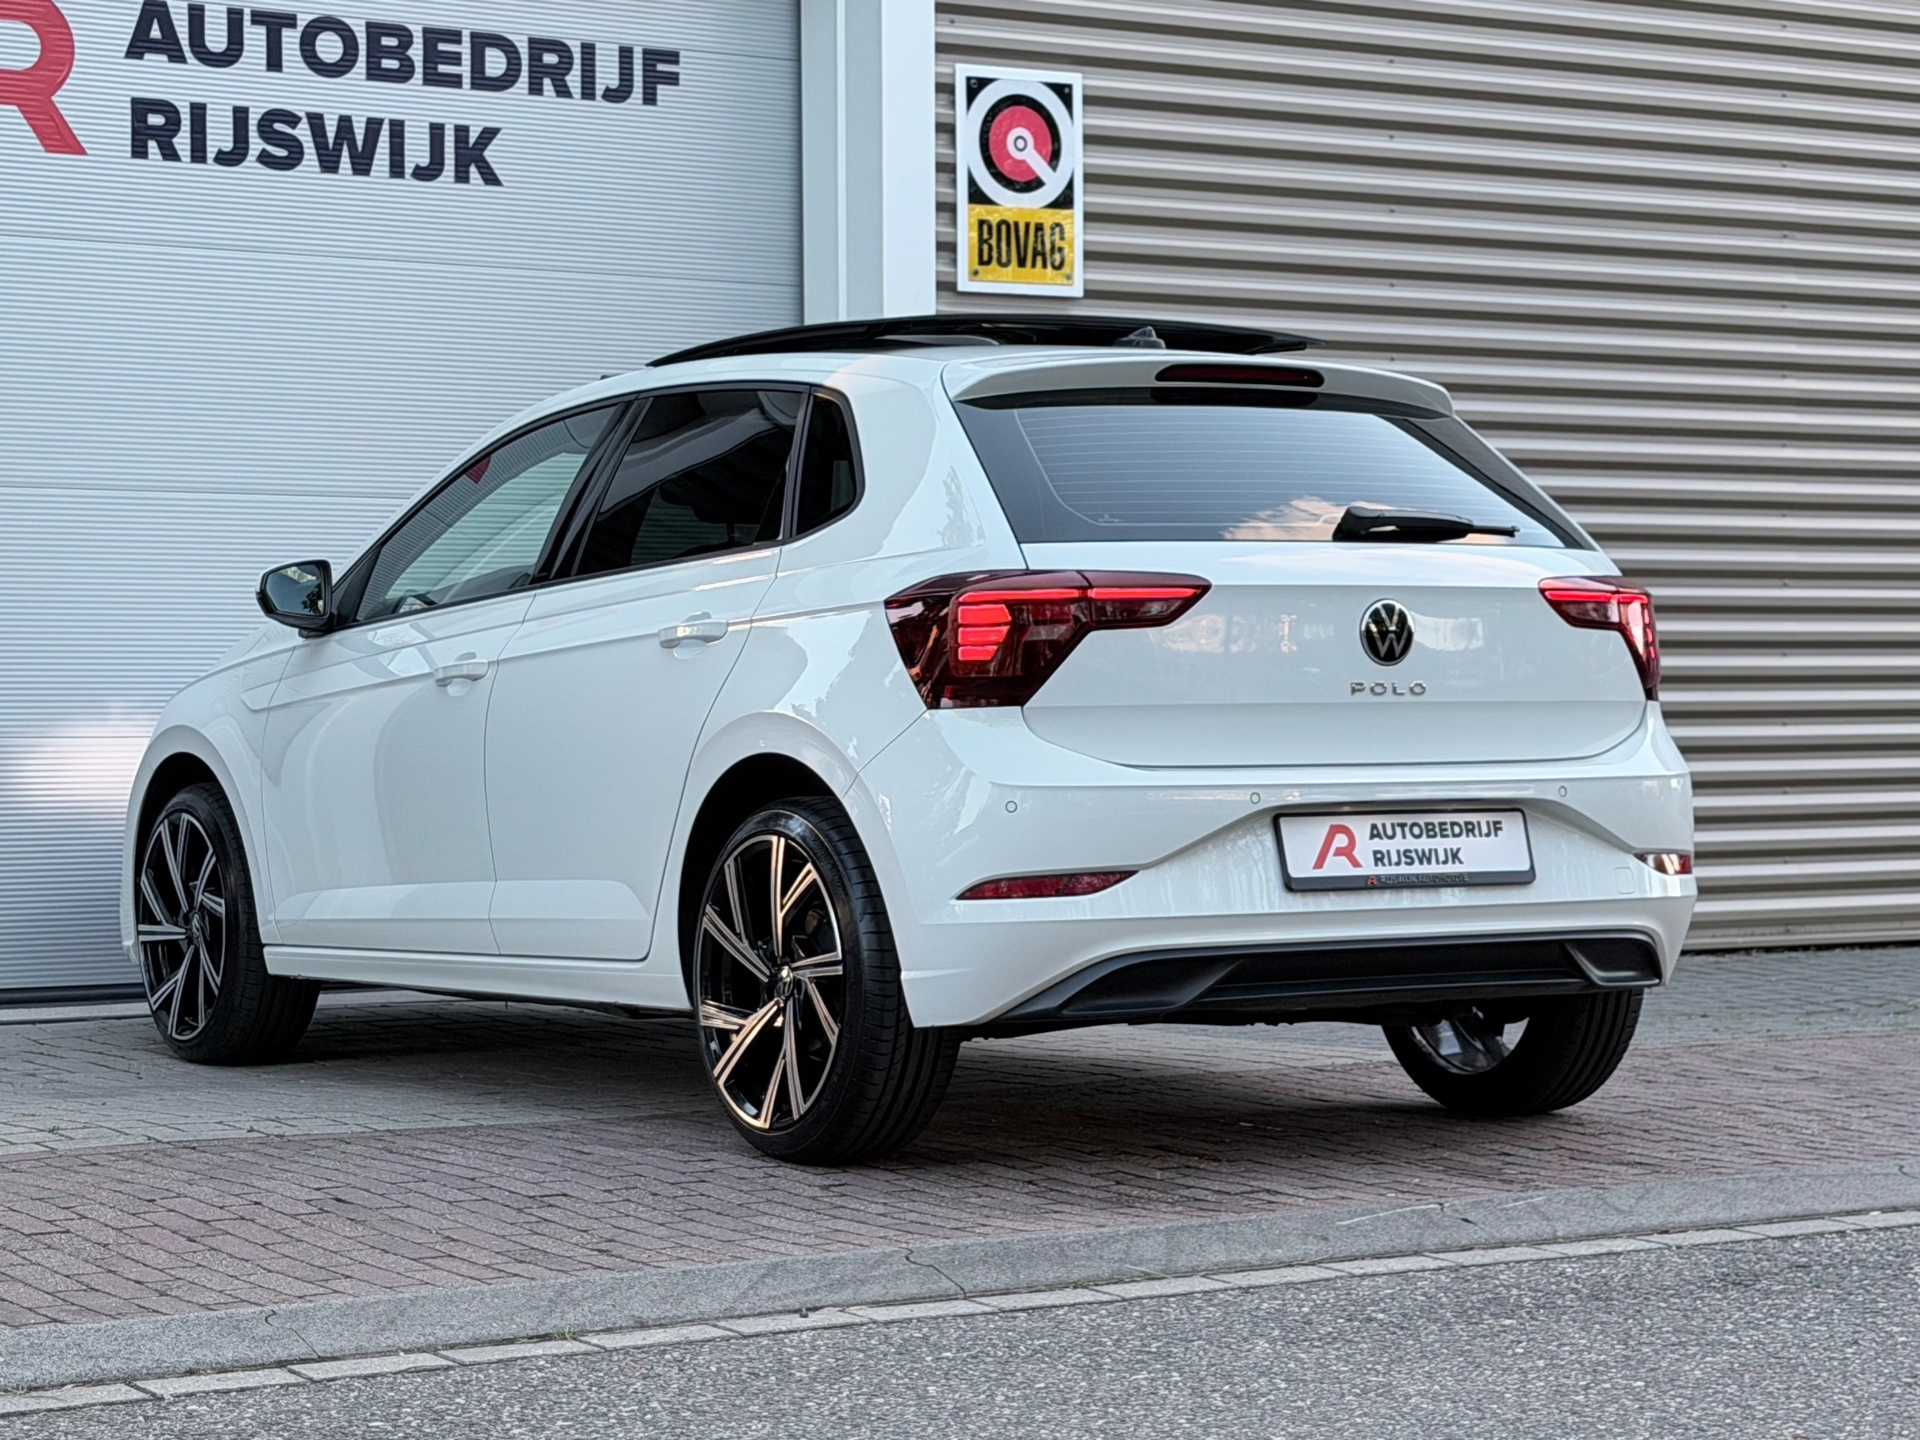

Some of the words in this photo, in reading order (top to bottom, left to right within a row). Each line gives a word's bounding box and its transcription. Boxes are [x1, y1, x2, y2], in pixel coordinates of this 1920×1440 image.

[124, 0, 681, 106] AUTOBEDRIJF
[130, 97, 504, 187] RIJSWIJK
[977, 218, 1066, 271] BOVAG
[1350, 681, 1427, 696] POLO
[1368, 820, 1503, 841] AUTOBEDRIJF
[1373, 847, 1464, 867] RIJSWIJK
